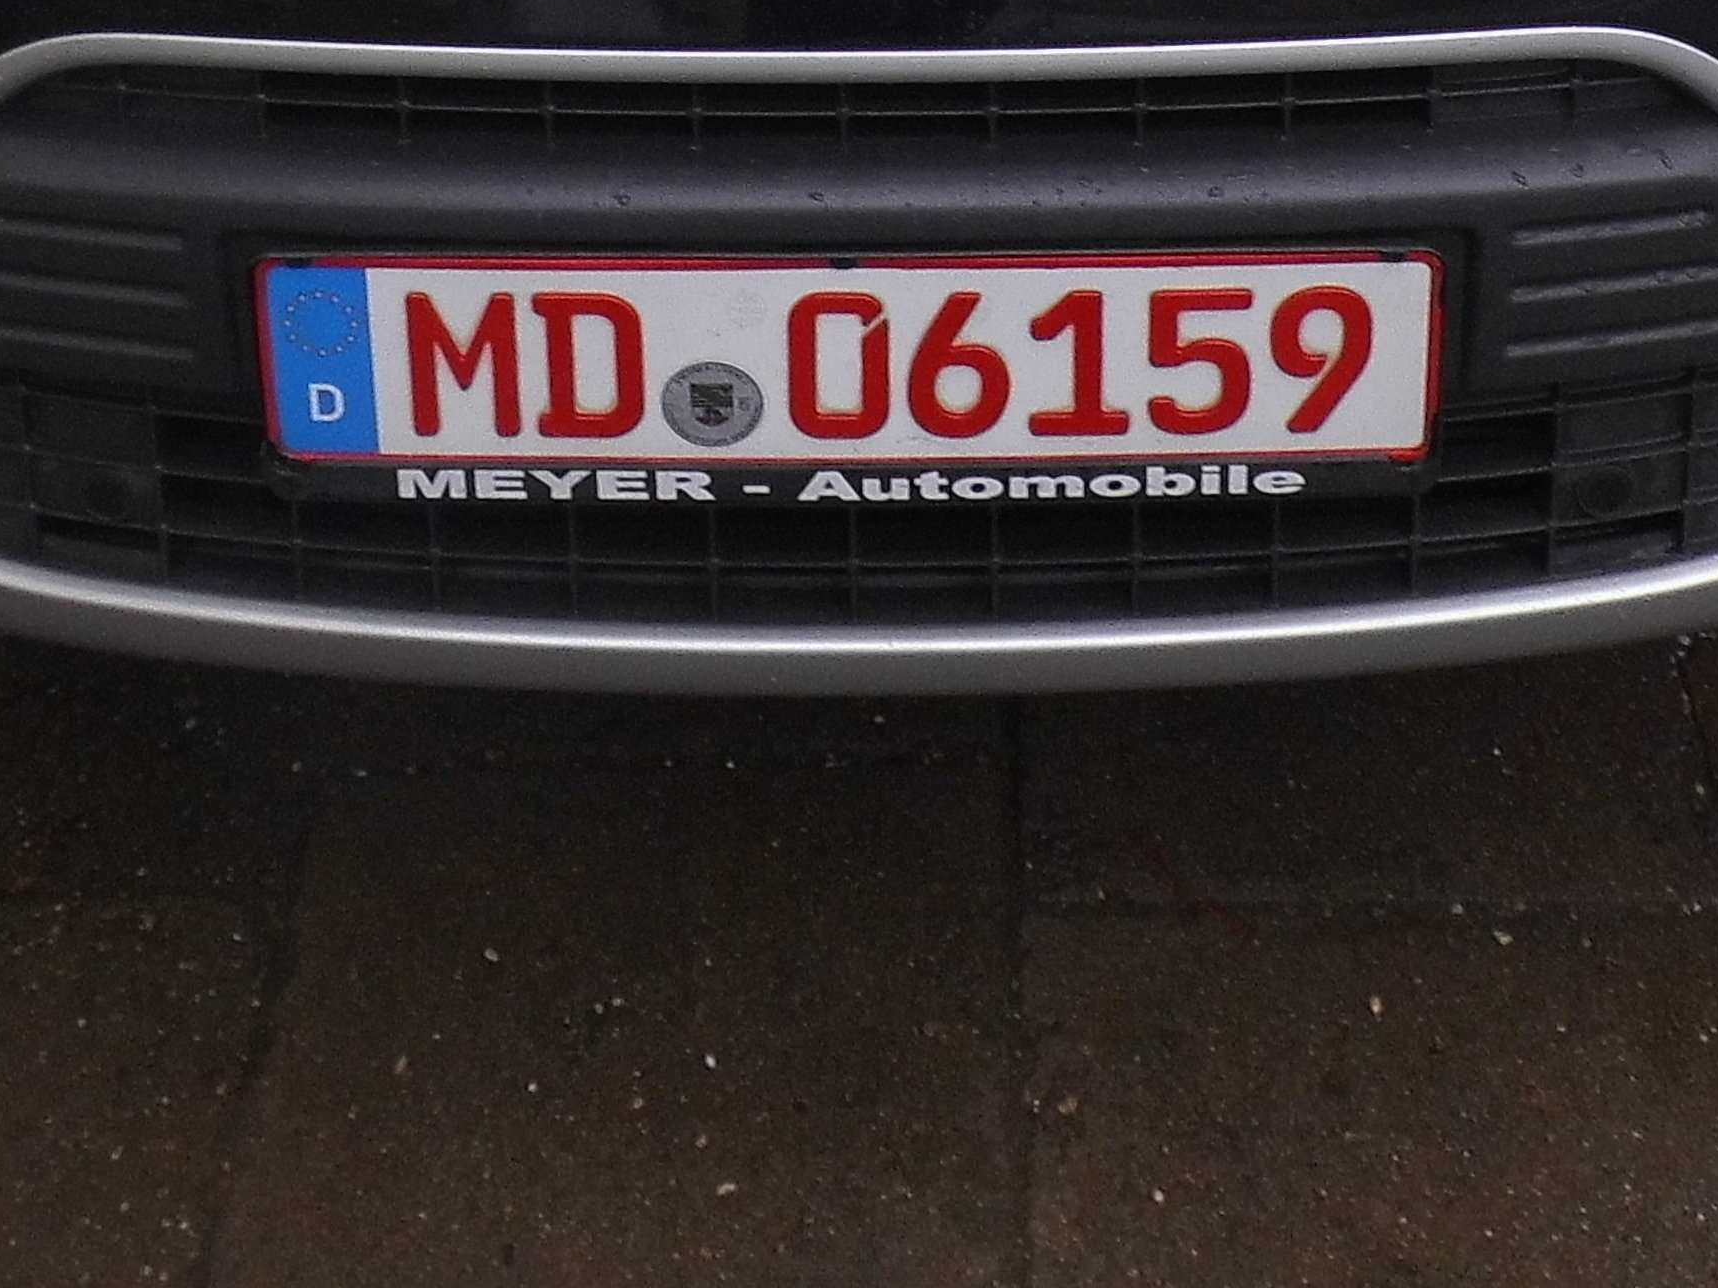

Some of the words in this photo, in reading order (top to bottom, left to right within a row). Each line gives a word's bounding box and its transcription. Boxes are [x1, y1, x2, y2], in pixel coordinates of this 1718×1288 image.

[405, 289, 648, 440] MD
[788, 285, 1376, 441] 06159
[307, 380, 346, 424] D
[396, 468, 717, 502] MEYER
[797, 464, 1307, 502] Automobile
